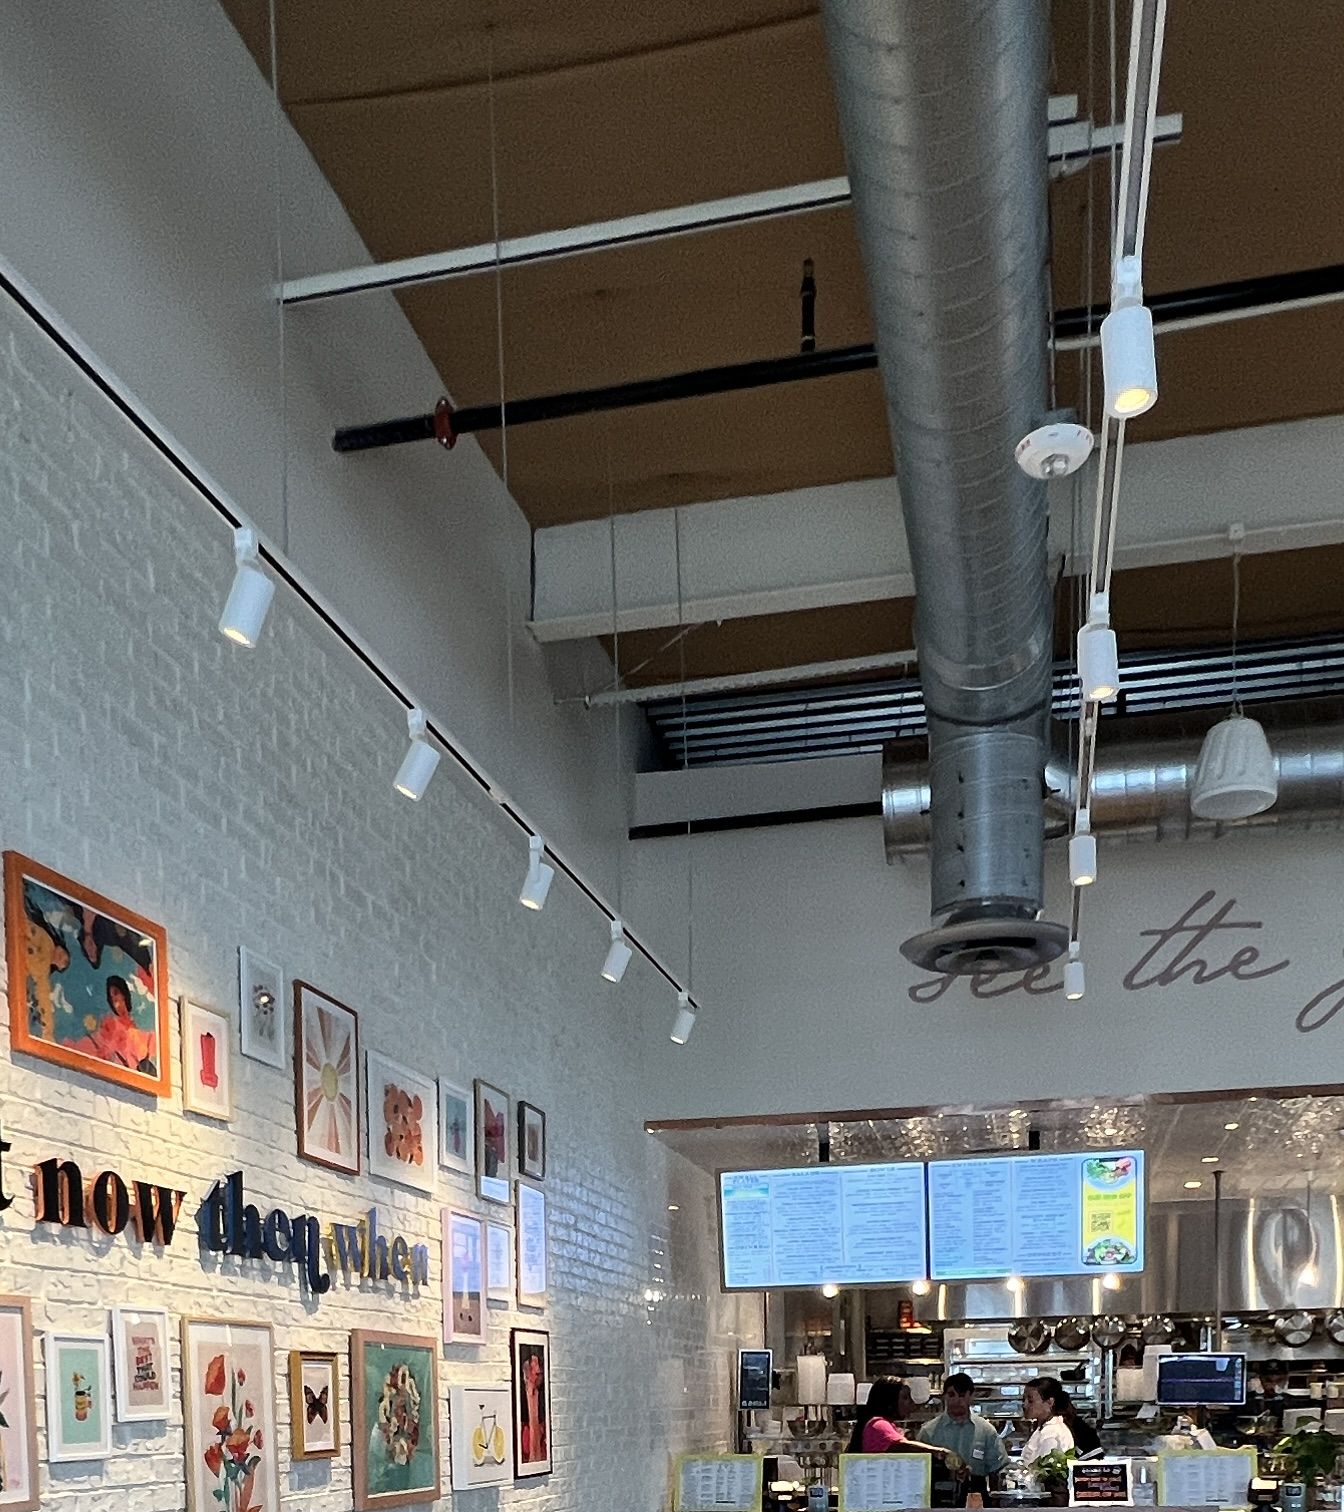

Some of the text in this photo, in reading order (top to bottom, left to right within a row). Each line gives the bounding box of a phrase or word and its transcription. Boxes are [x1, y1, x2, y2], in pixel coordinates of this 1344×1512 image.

[1122, 889, 1291, 991] the
[33, 1157, 188, 1246] now
[322, 1206, 430, 1287] when
